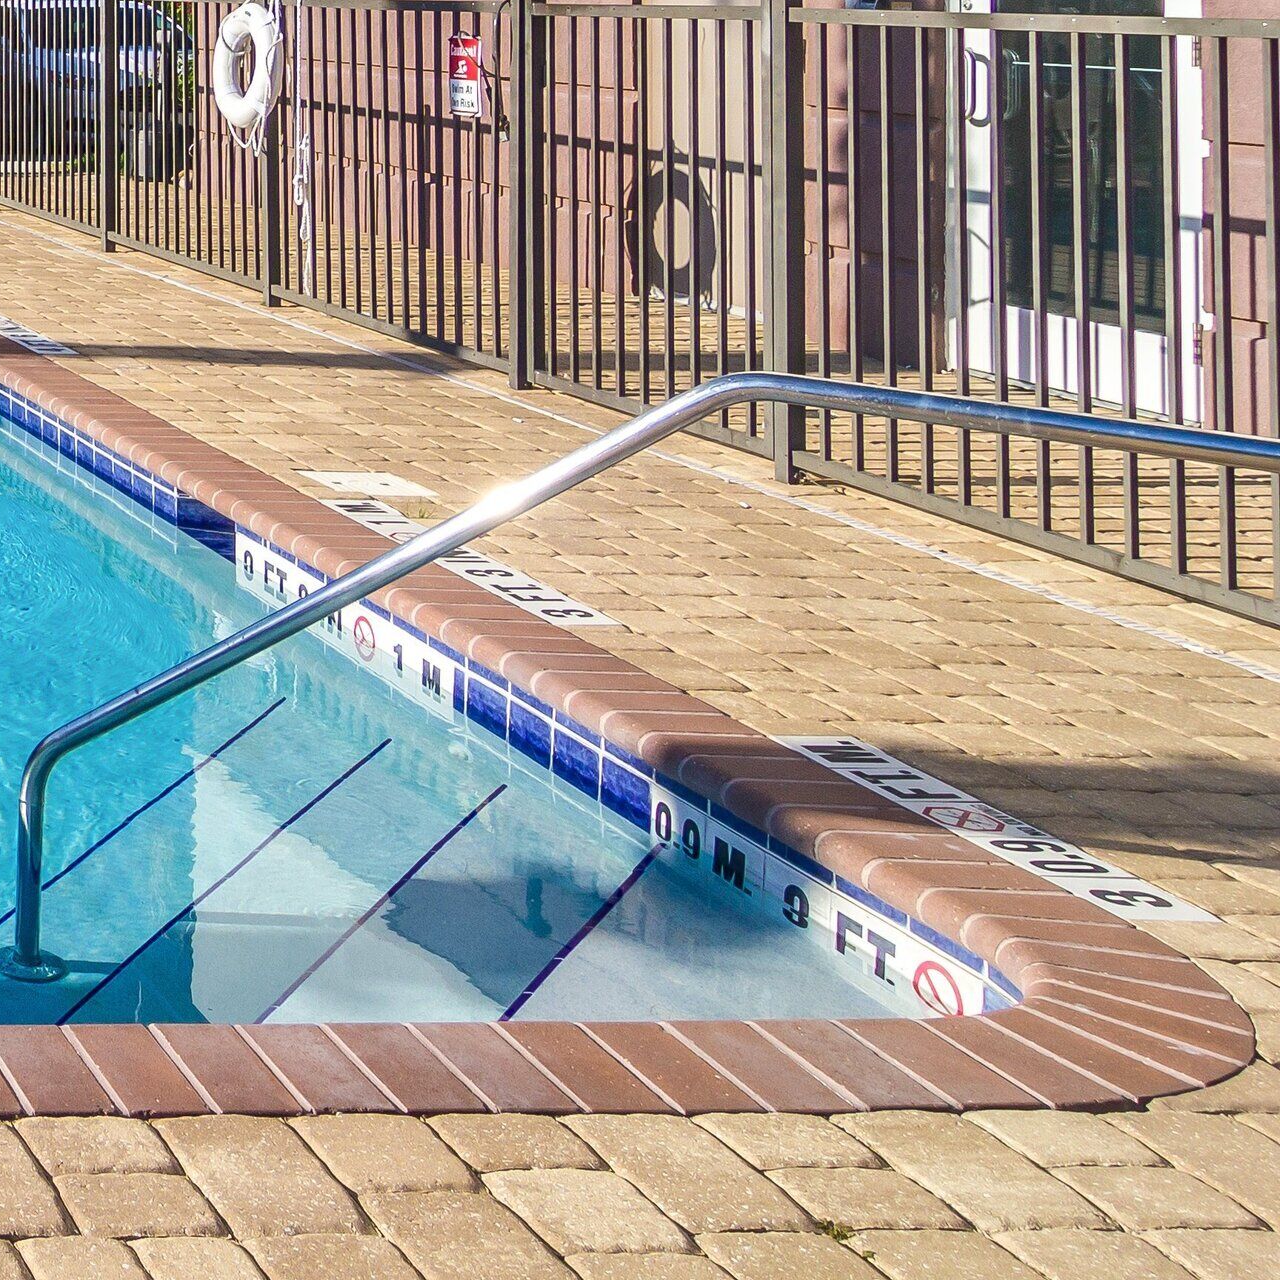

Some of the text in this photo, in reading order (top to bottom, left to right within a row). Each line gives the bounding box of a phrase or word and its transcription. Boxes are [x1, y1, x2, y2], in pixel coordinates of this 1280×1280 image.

[460, 98, 475, 109] Risk
[464, 569, 515, 578] 3
[540, 608, 595, 619] 3
[989, 839, 1110, 874] 0.9
[1088, 889, 1173, 908] 3
